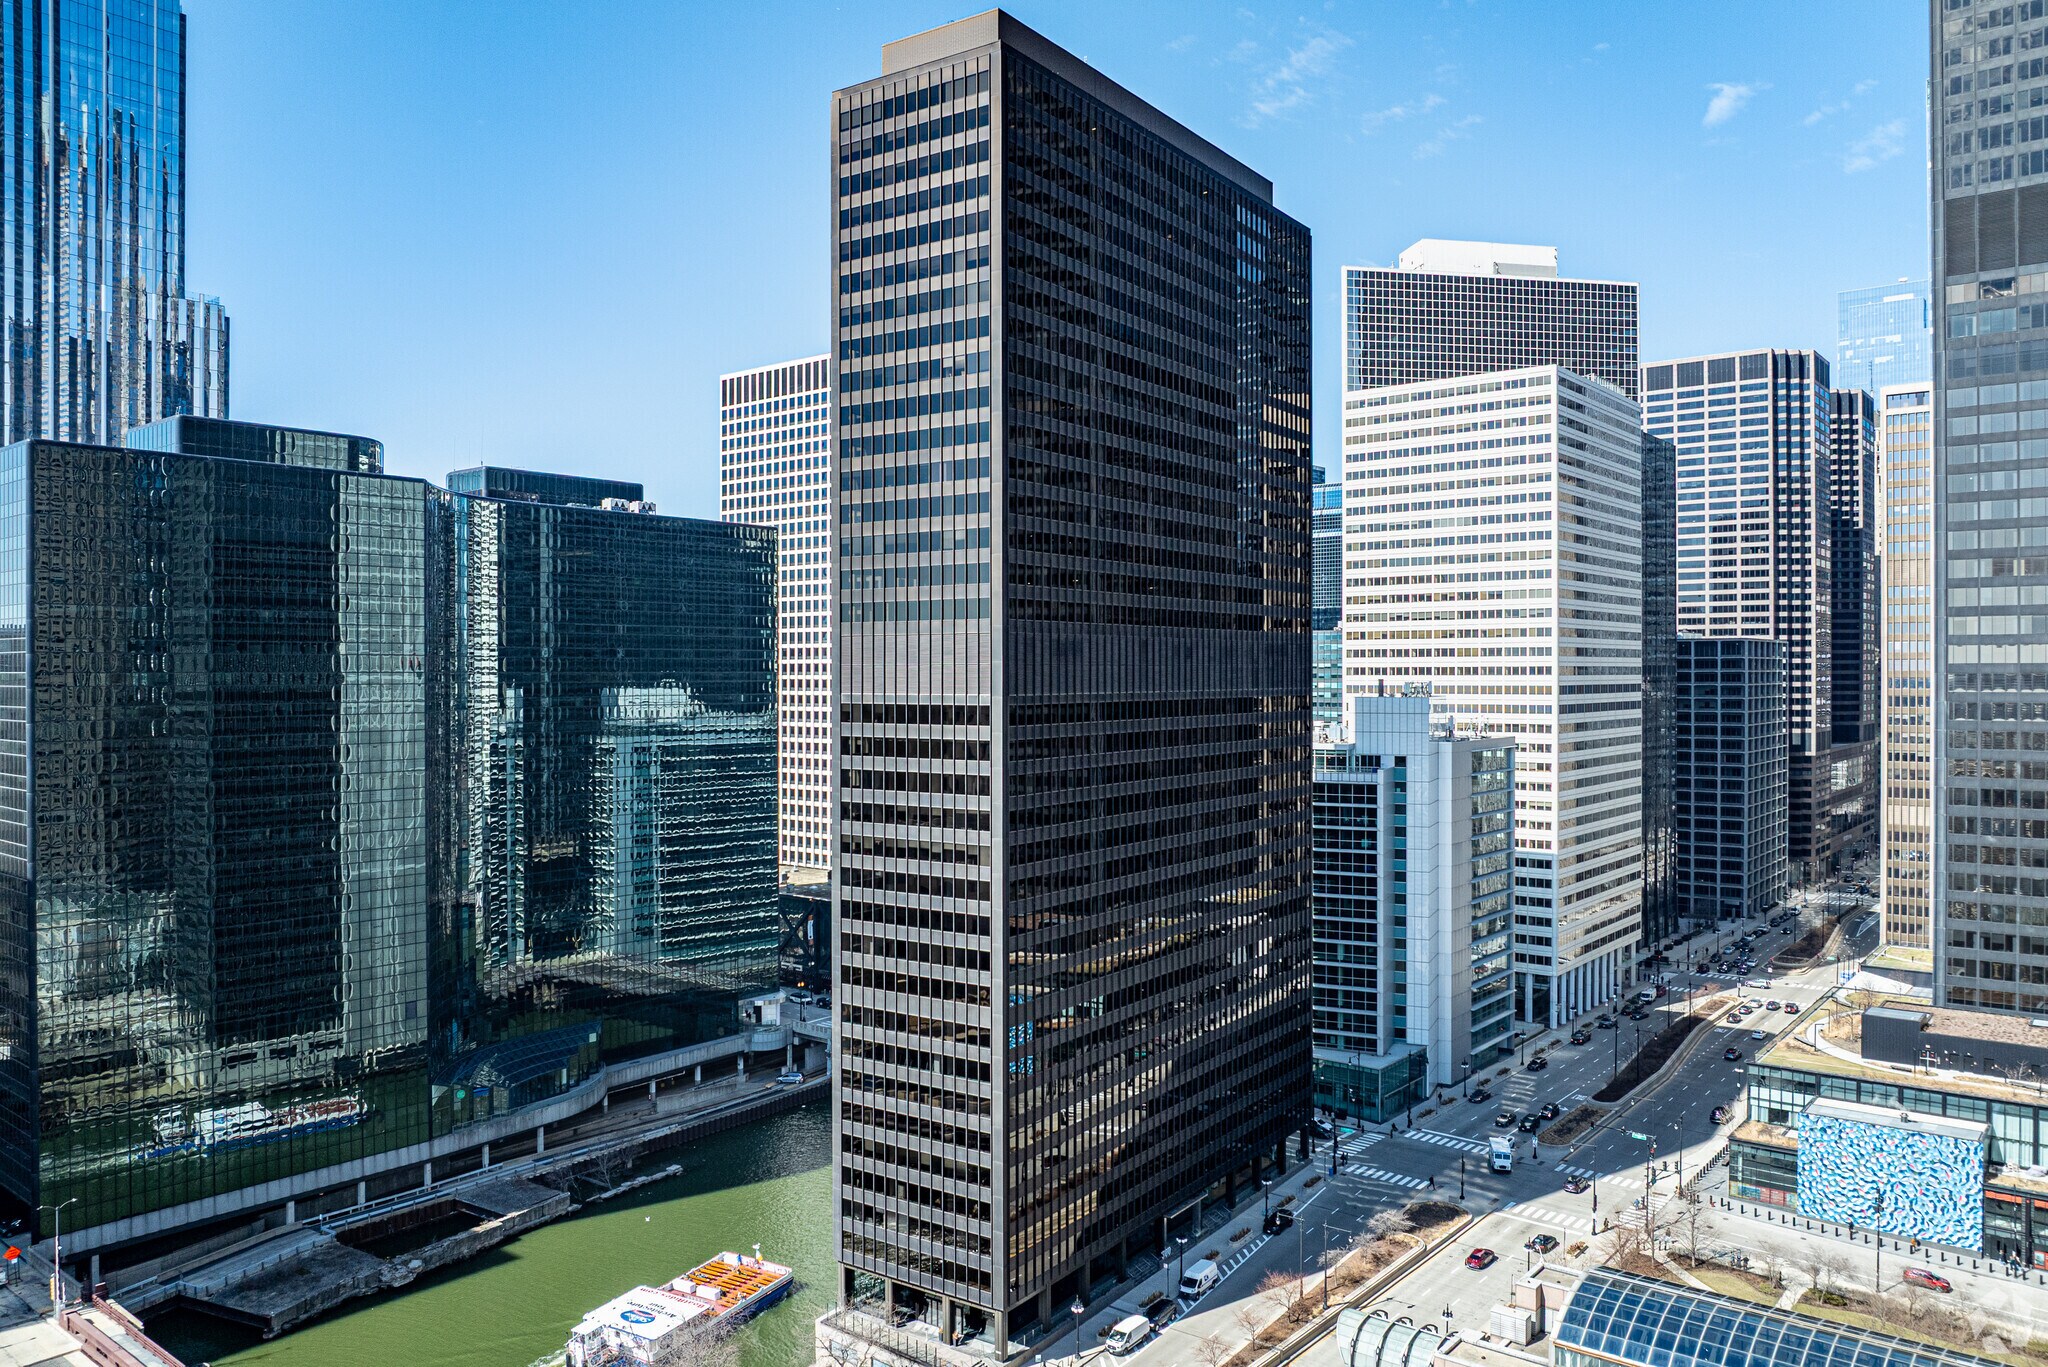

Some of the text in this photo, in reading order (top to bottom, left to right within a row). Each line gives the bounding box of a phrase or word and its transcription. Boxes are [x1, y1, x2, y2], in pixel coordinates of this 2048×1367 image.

[640, 1287, 706, 1309] BoatRides.com
[648, 1302, 666, 1310] Tour
[626, 1301, 677, 1318] Architecture
